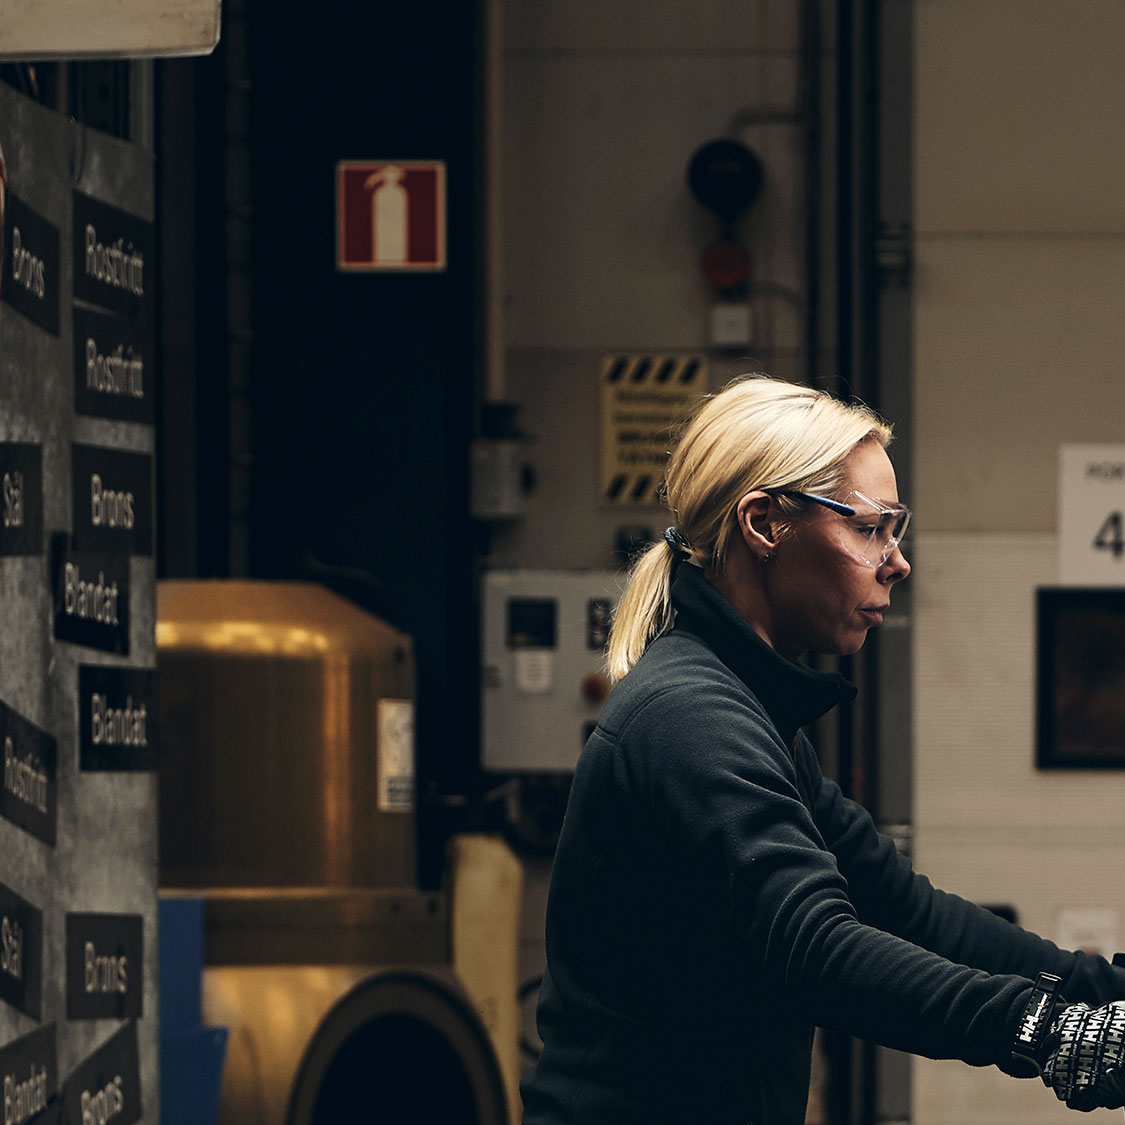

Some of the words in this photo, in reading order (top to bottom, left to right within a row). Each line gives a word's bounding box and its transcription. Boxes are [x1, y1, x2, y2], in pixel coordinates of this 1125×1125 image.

[12, 225, 45, 300] Brons
[85, 223, 144, 297] Rostfritt
[85, 337, 144, 399] Rostfritt
[90, 472, 135, 530] Brons
[1093, 510, 1125, 558] 4
[64, 561, 119, 626] Blandat
[91, 692, 148, 746] Blandat
[84, 940, 128, 994] Brons
